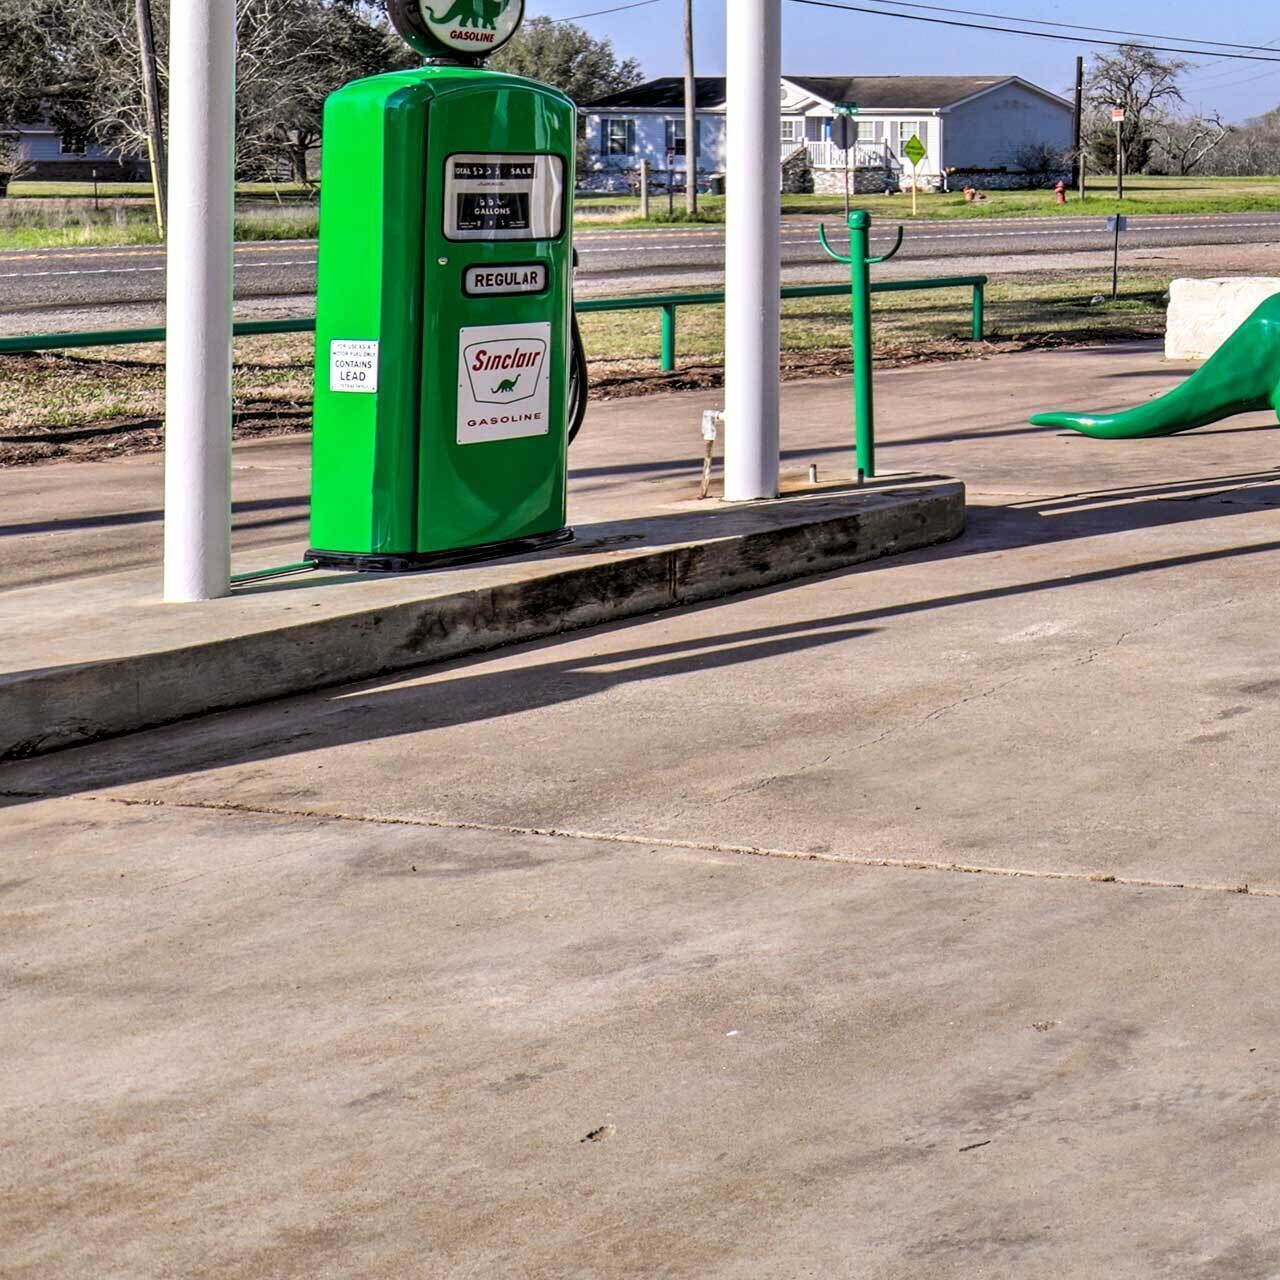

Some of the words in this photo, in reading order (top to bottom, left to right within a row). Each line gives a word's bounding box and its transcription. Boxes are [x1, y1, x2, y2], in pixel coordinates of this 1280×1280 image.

[450, 31, 495, 43] GASOLINE
[511, 167, 532, 175] SALE
[475, 271, 538, 287] REGULAR
[335, 360, 372, 368] CONTAINS
[473, 348, 541, 371] Sinclair
[341, 371, 366, 381] LEAD
[467, 413, 541, 427] GASOLINE
